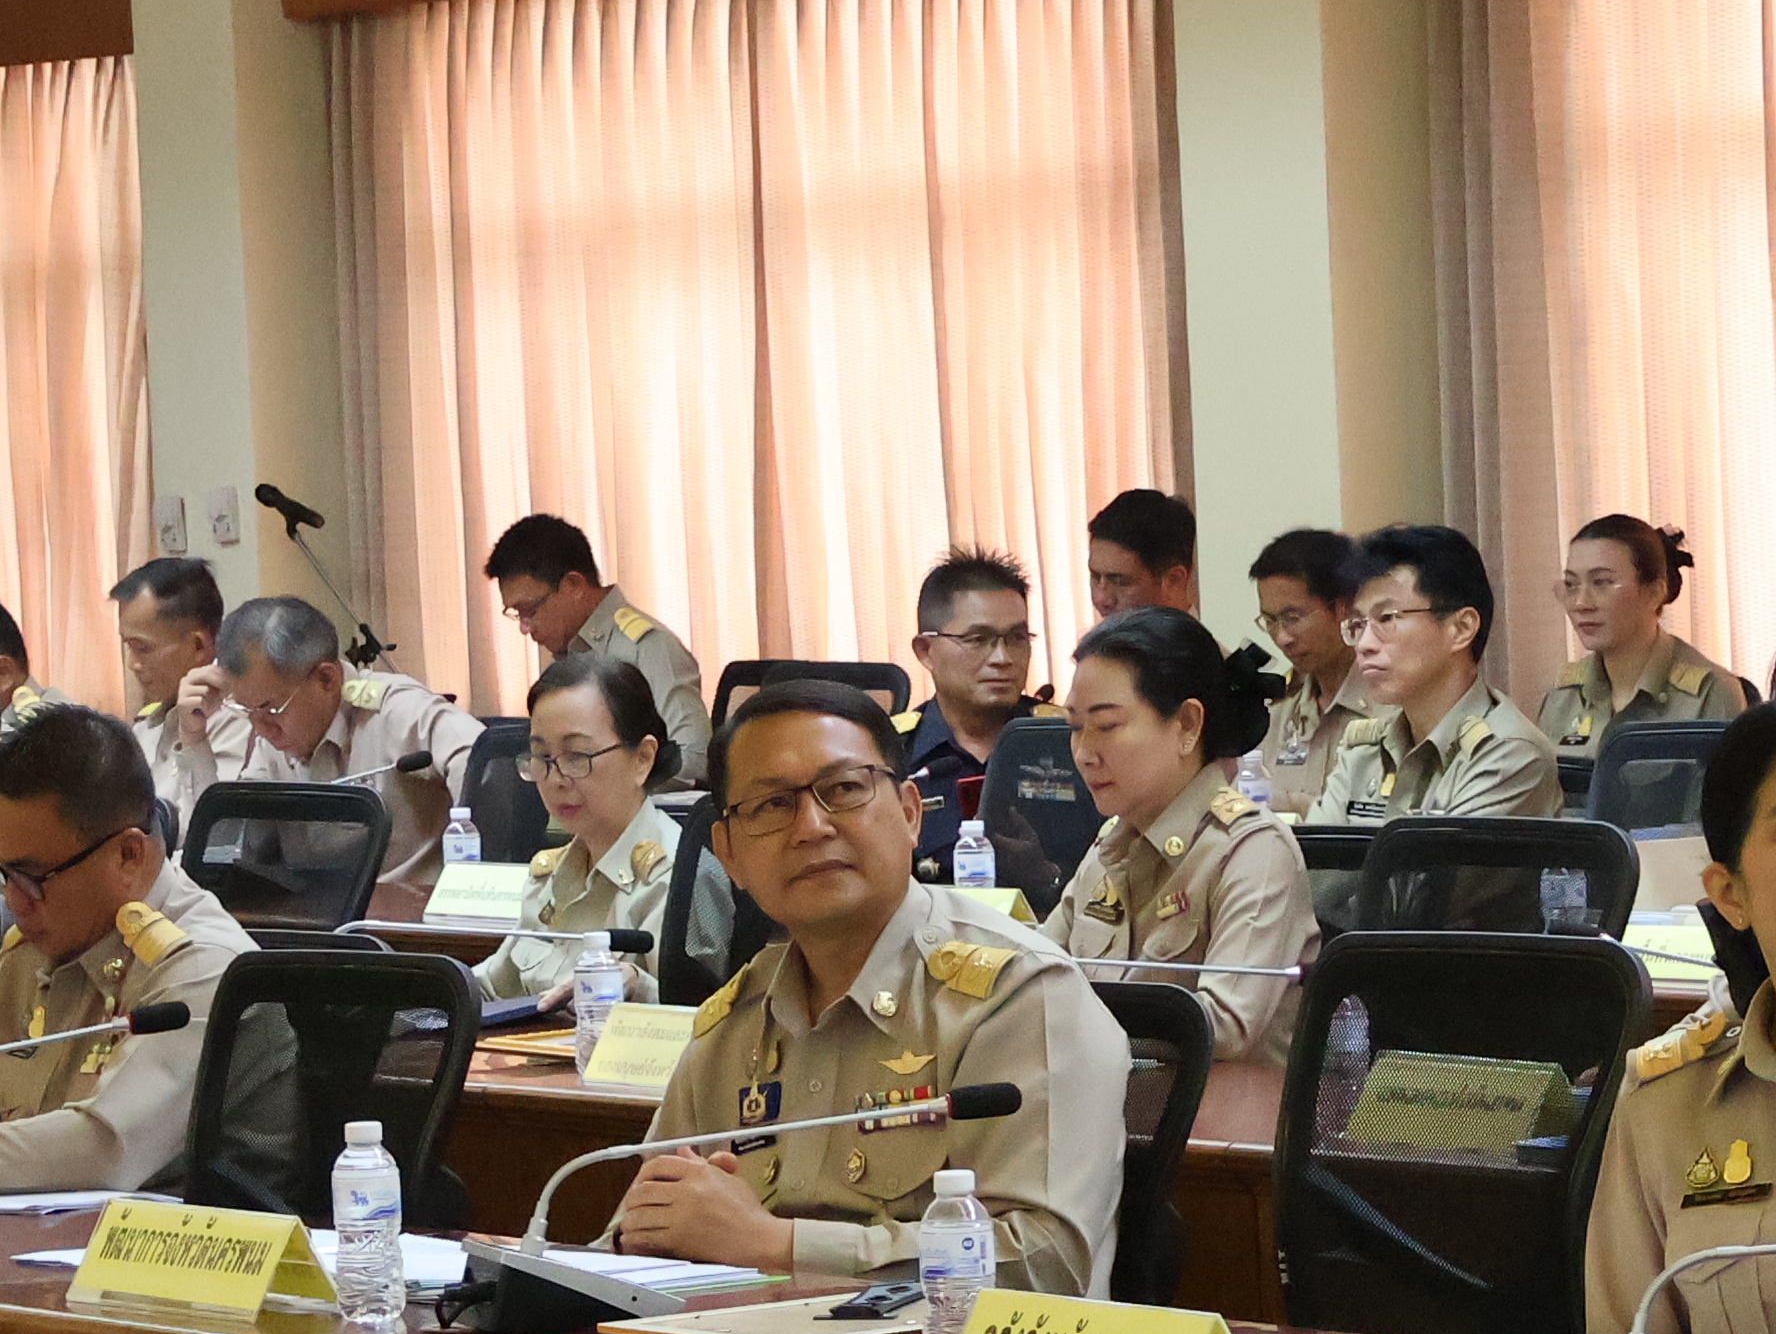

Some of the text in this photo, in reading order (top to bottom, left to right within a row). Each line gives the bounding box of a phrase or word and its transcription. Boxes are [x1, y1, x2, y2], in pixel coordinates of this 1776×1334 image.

[99, 1207, 273, 1277] พัฒนาการจังหวัดนครพนม
